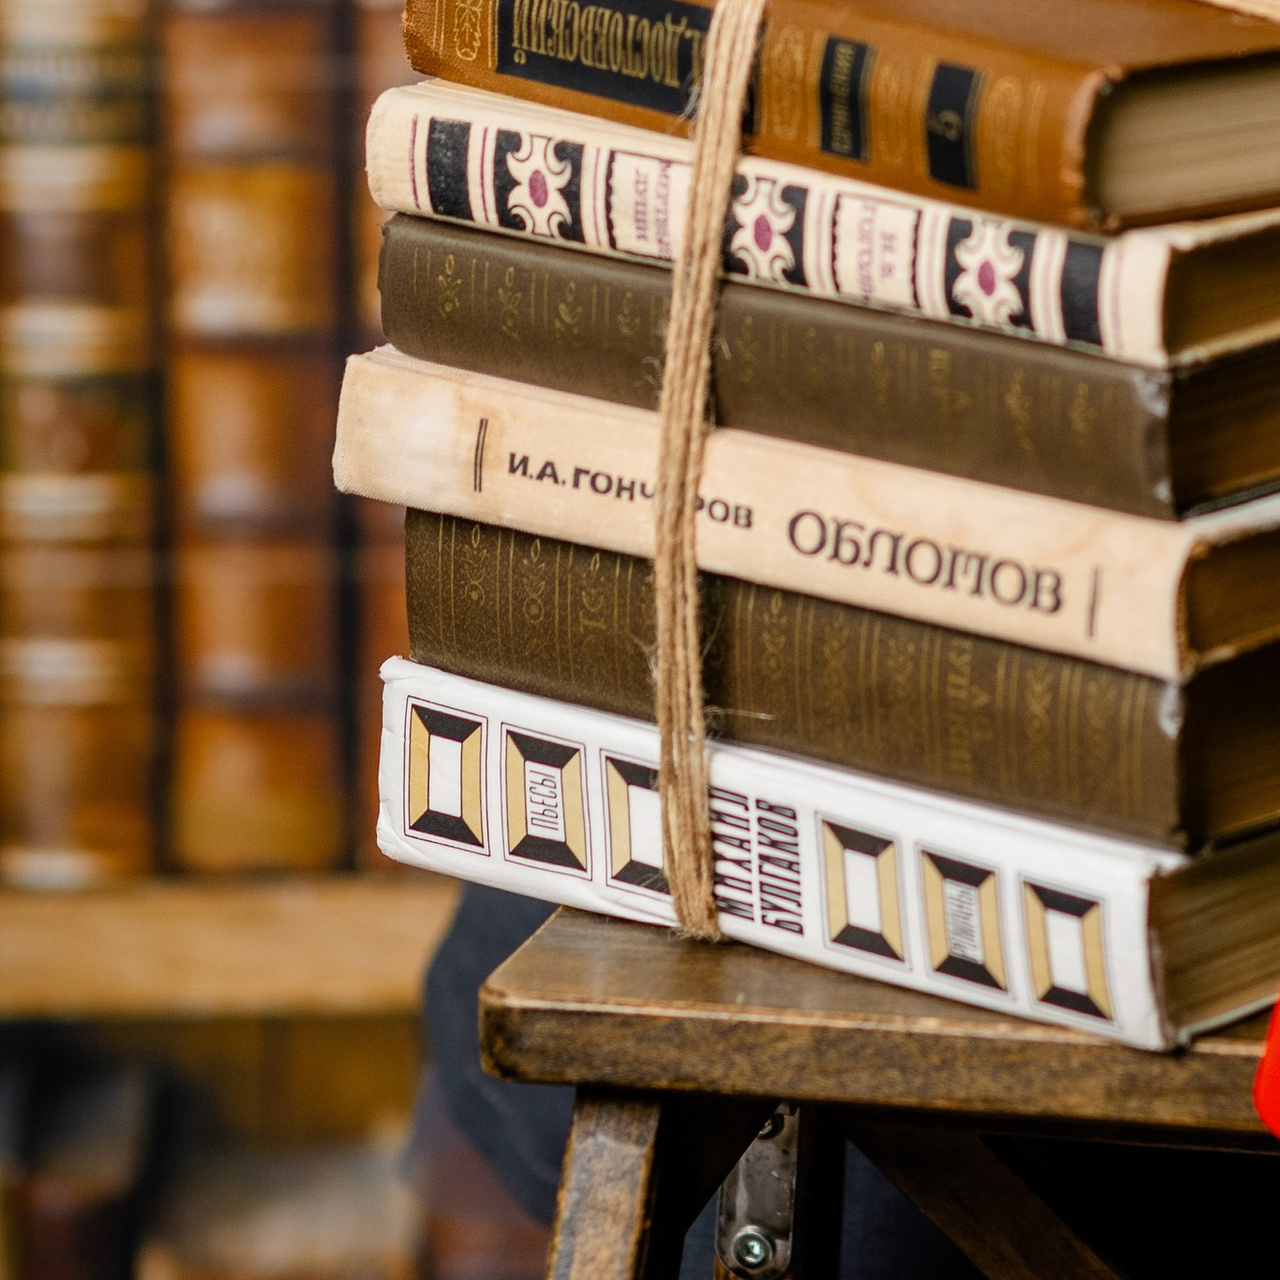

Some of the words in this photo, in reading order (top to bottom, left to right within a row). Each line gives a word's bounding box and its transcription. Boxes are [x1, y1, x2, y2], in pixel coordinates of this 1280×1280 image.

[787, 508, 1064, 615] ОБЛОМОВ
[528, 769, 560, 832] ПЬЕСЫ
[711, 785, 755, 922] МИХАИЛ
[756, 798, 803, 936] БУЛГАКОВ
